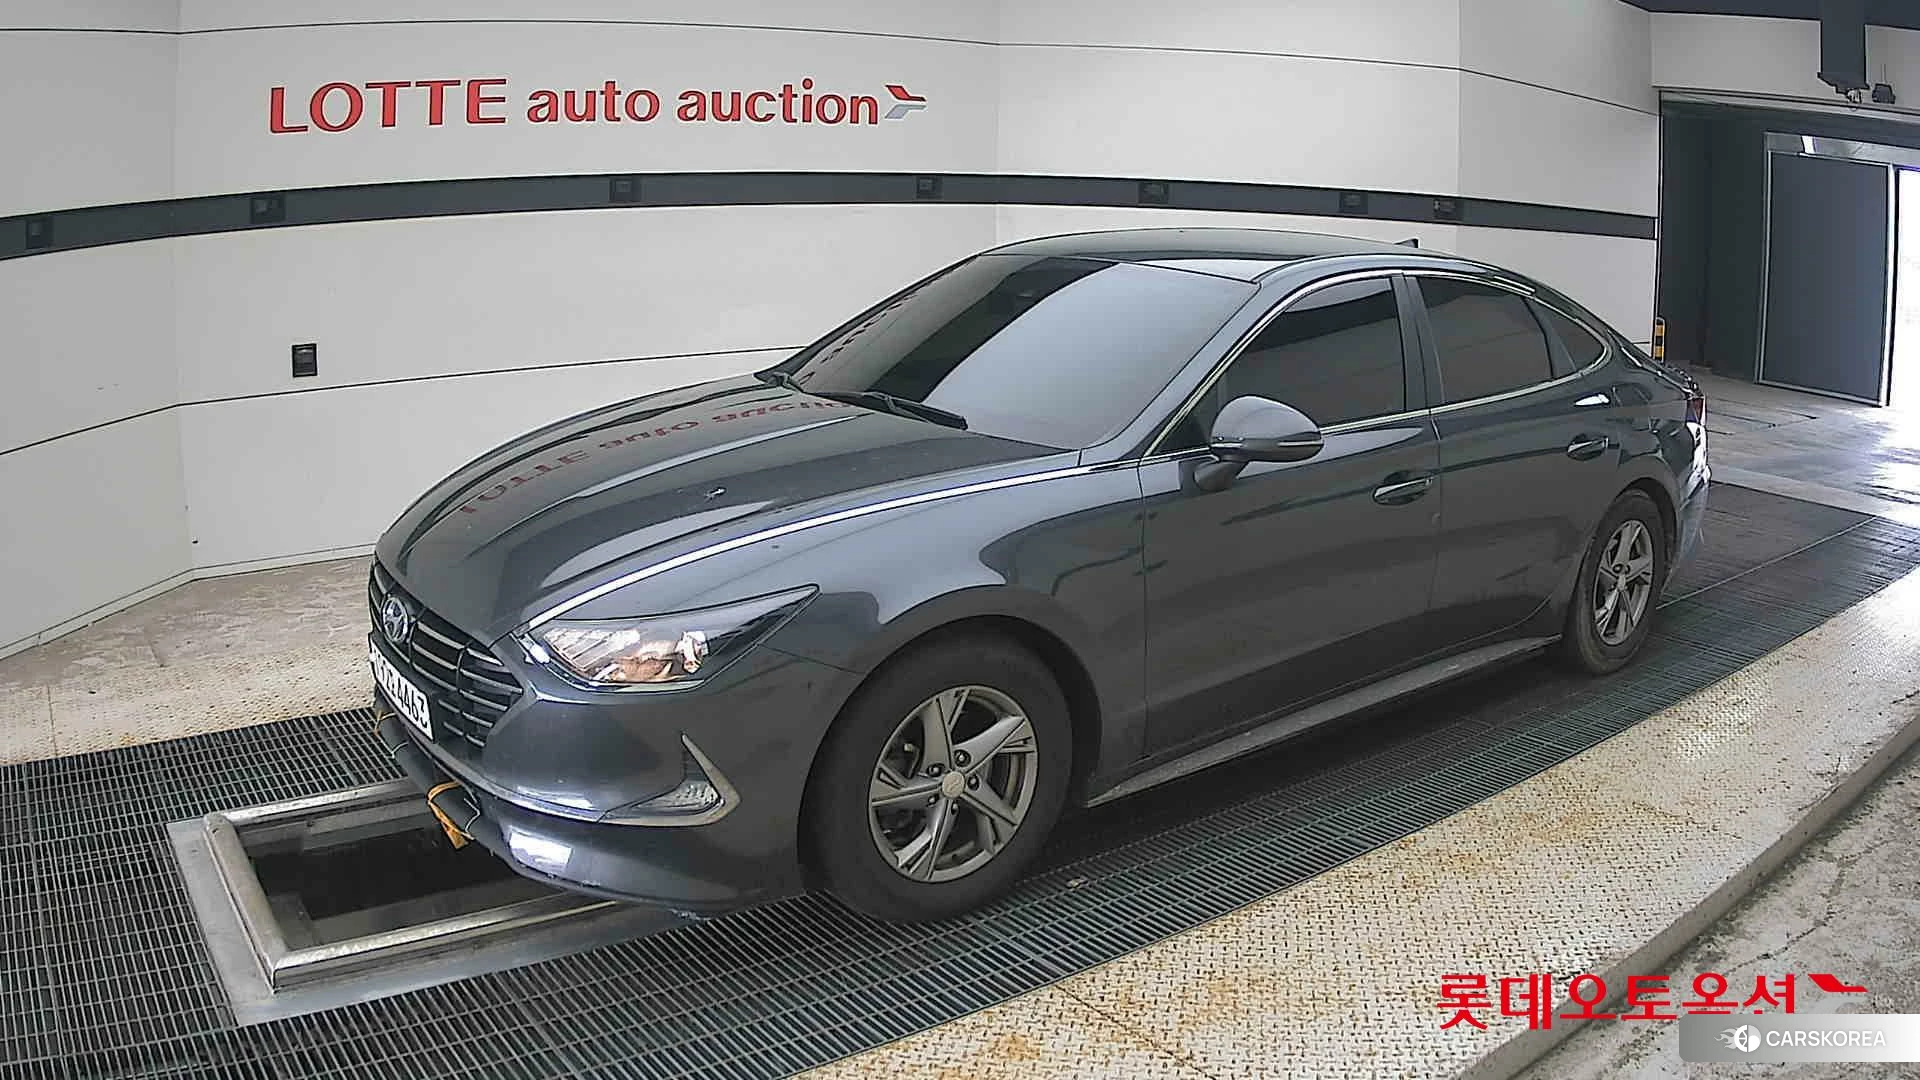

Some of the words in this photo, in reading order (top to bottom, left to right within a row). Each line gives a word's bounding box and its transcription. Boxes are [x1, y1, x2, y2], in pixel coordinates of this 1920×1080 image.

[269, 79, 505, 134] LOTTE
[527, 80, 661, 123] auto
[677, 78, 879, 125] auction
